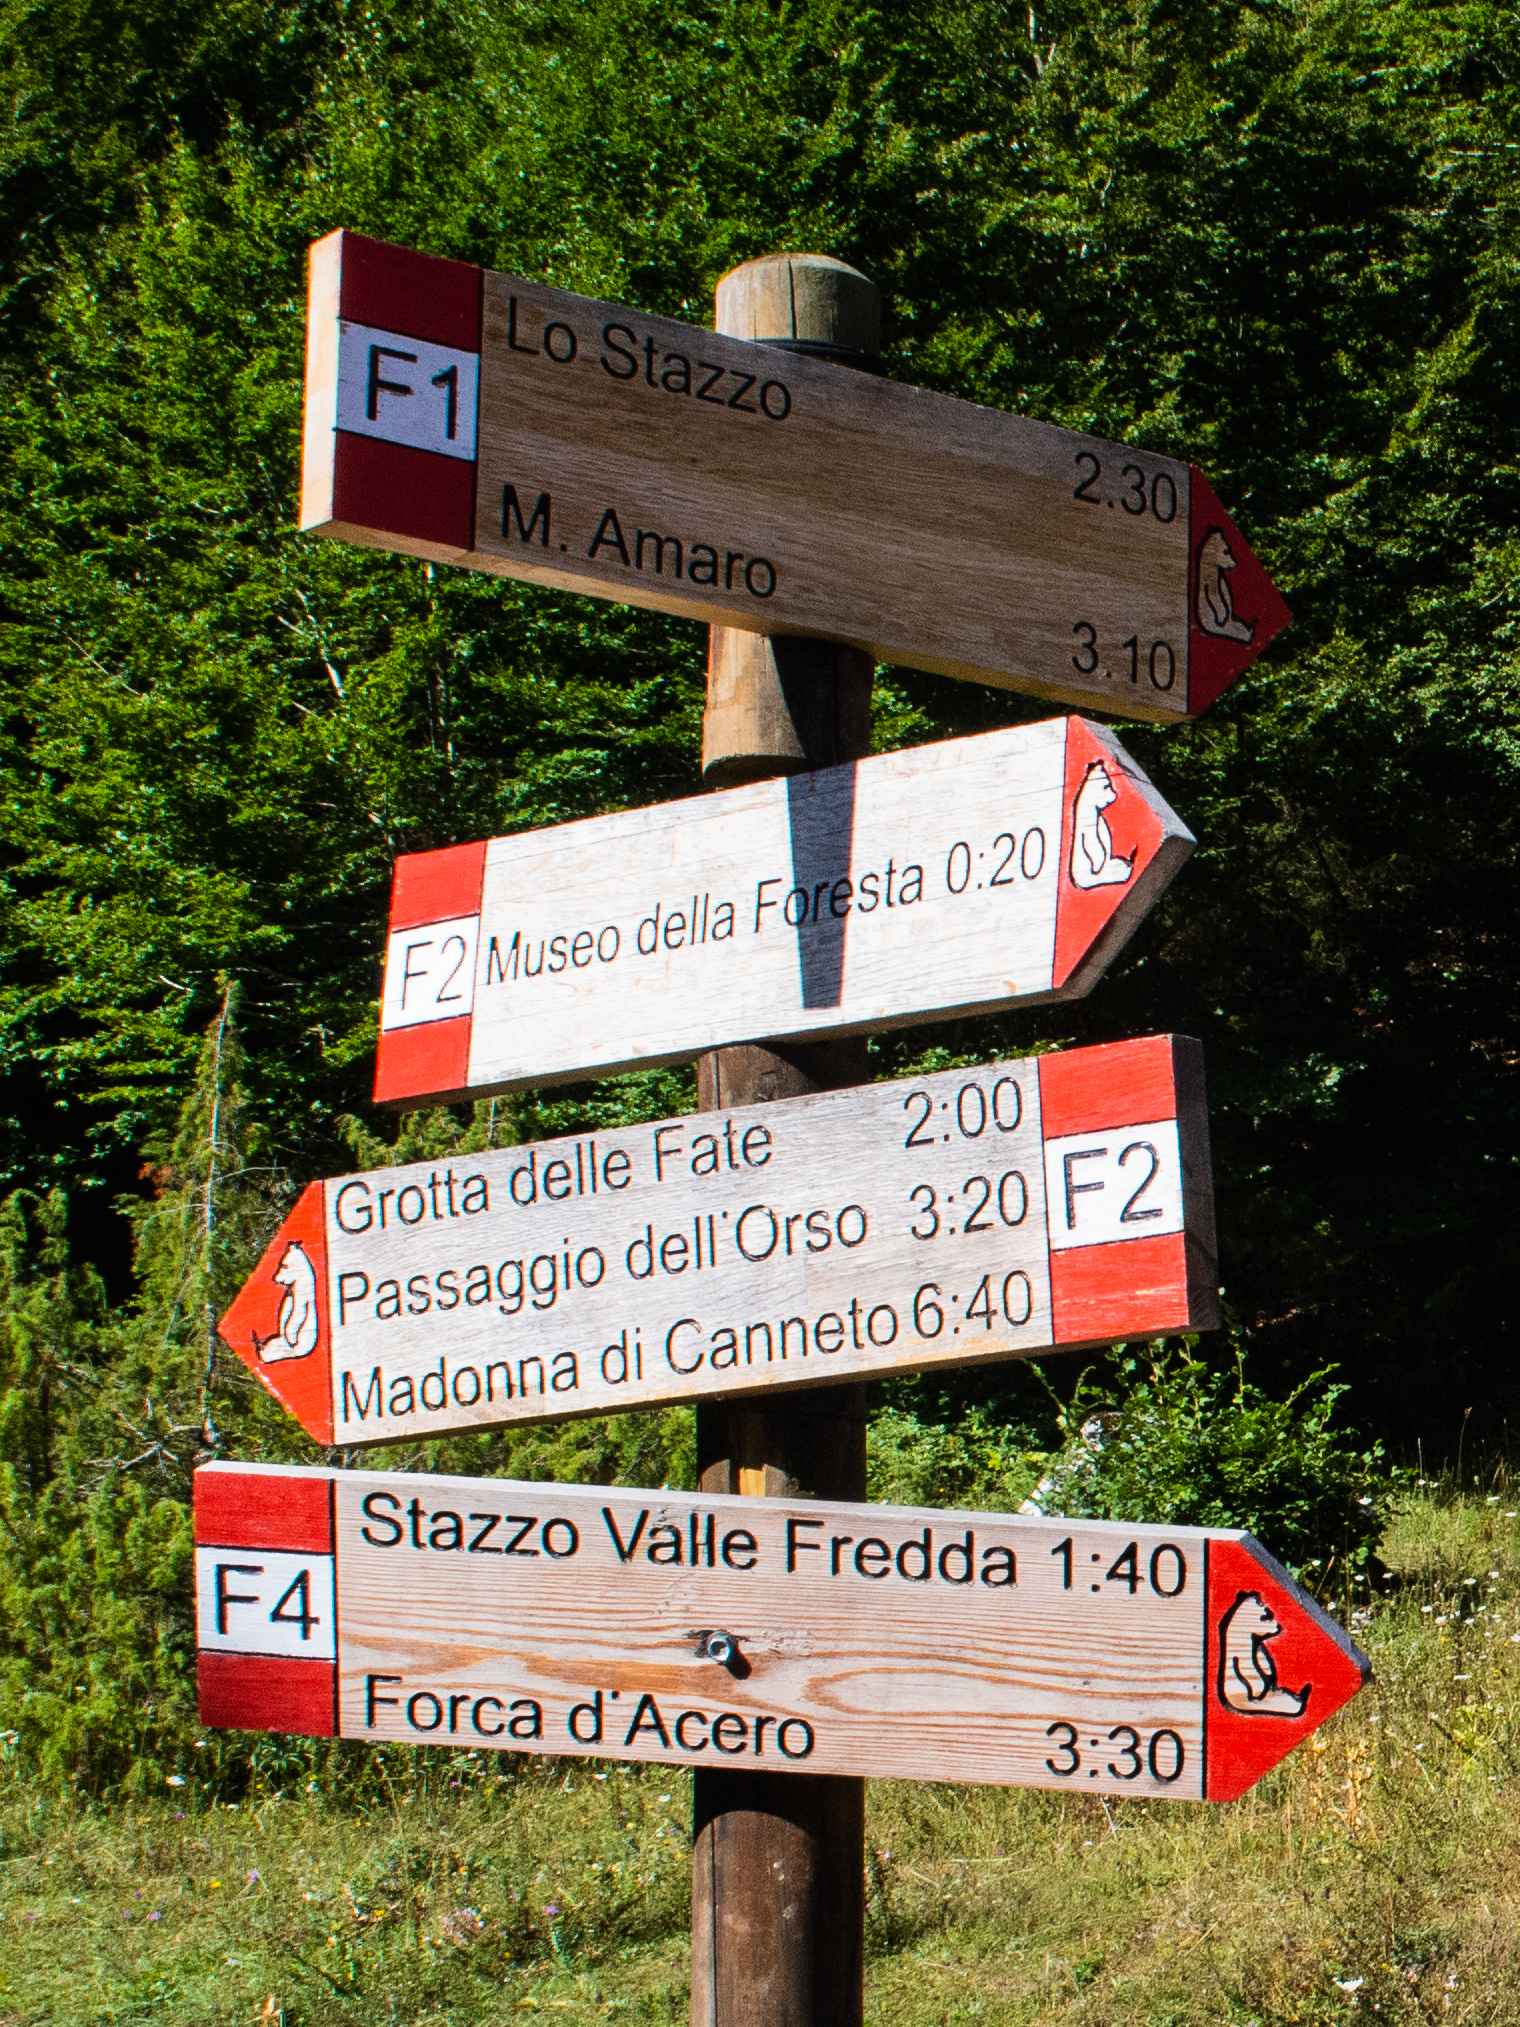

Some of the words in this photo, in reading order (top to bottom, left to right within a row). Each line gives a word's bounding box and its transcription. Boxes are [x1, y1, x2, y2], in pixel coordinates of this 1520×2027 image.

[366, 344, 458, 440] F1
[508, 296, 578, 364] Lo
[600, 322, 793, 421] Stazzo
[1073, 451, 1178, 523] 2.30
[500, 483, 568, 553] M.
[588, 509, 778, 598] Amaro
[1071, 621, 1175, 690] 3.10
[401, 935, 467, 1010] F2
[485, 925, 621, 986] Museo
[637, 893, 735, 957] della
[754, 857, 925, 934] Foresta
[945, 826, 1046, 894] 0:20
[335, 1169, 490, 1235] Grotta
[510, 1139, 632, 1204] delle
[654, 1118, 773, 1182] Fate
[902, 1076, 1024, 1149] 2:00
[1063, 1140, 1164, 1230] F2
[337, 1239, 606, 1326] Passaggio
[626, 1199, 868, 1281] dell'Orso
[910, 1170, 1029, 1241] 3:20
[341, 1348, 580, 1426] Madonna
[601, 1328, 643, 1384] di
[664, 1296, 898, 1375] Canneto
[911, 1269, 1032, 1339] 6:40
[214, 1565, 321, 1641] F4
[360, 1492, 580, 1558] Stazzo
[600, 1506, 758, 1571] Valle
[787, 1519, 1017, 1587] Fredda
[1050, 1537, 1187, 1597] 1:40
[366, 1674, 543, 1742] Forca
[567, 1688, 814, 1759] d'Acero
[1043, 1721, 1186, 1784] 3:30
